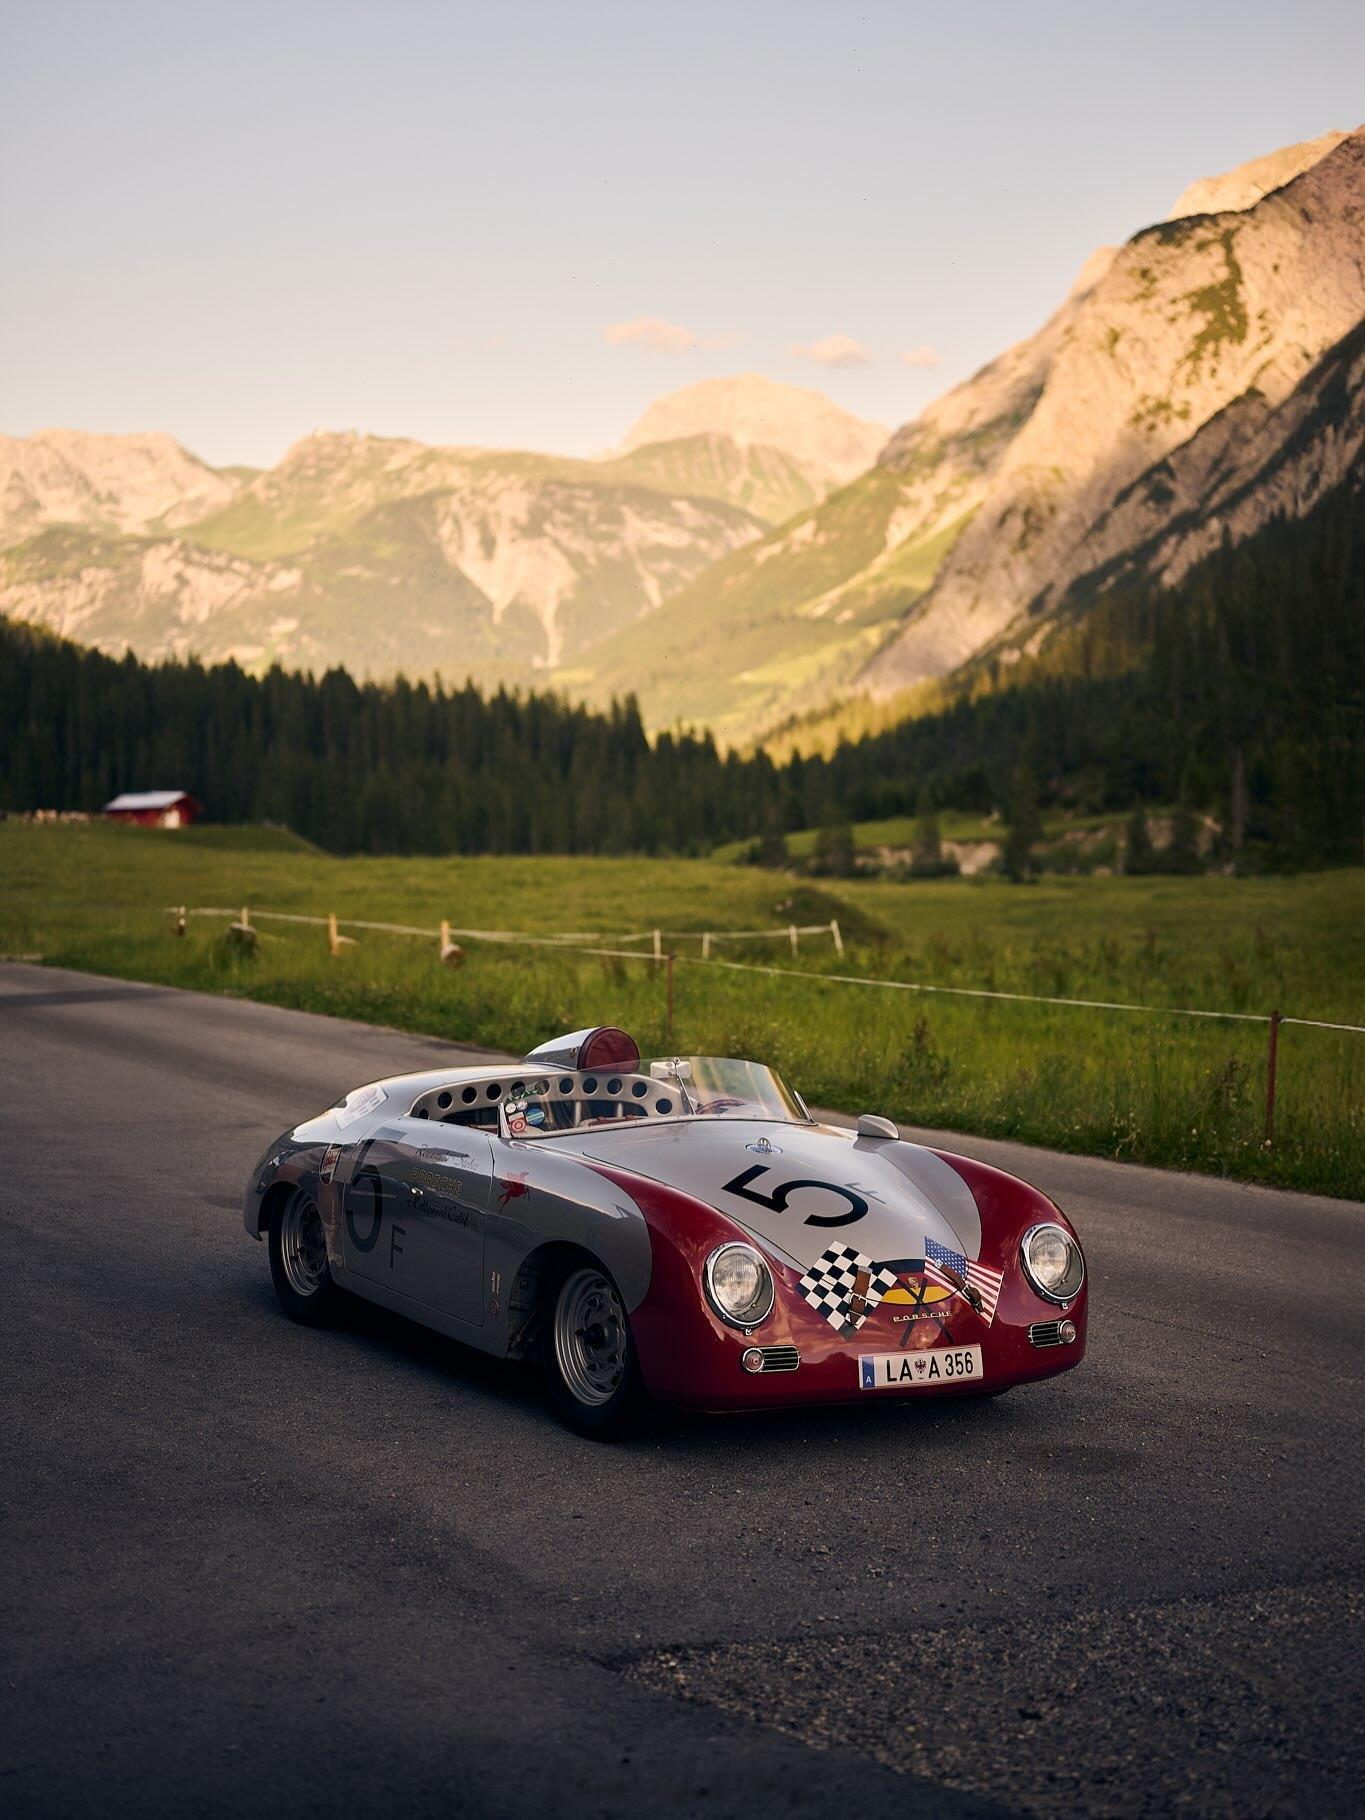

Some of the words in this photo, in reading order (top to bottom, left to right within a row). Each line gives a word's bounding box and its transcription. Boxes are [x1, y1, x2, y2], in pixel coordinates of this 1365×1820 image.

[410, 1167, 464, 1198] PORSCHE
[721, 1164, 868, 1227] 5
[390, 1223, 406, 1270] F
[892, 1310, 952, 1322] PORSCHE
[865, 1375, 873, 1384] A
[886, 1358, 913, 1382] LA
[928, 1355, 941, 1379] A
[944, 1351, 974, 1377] 356
